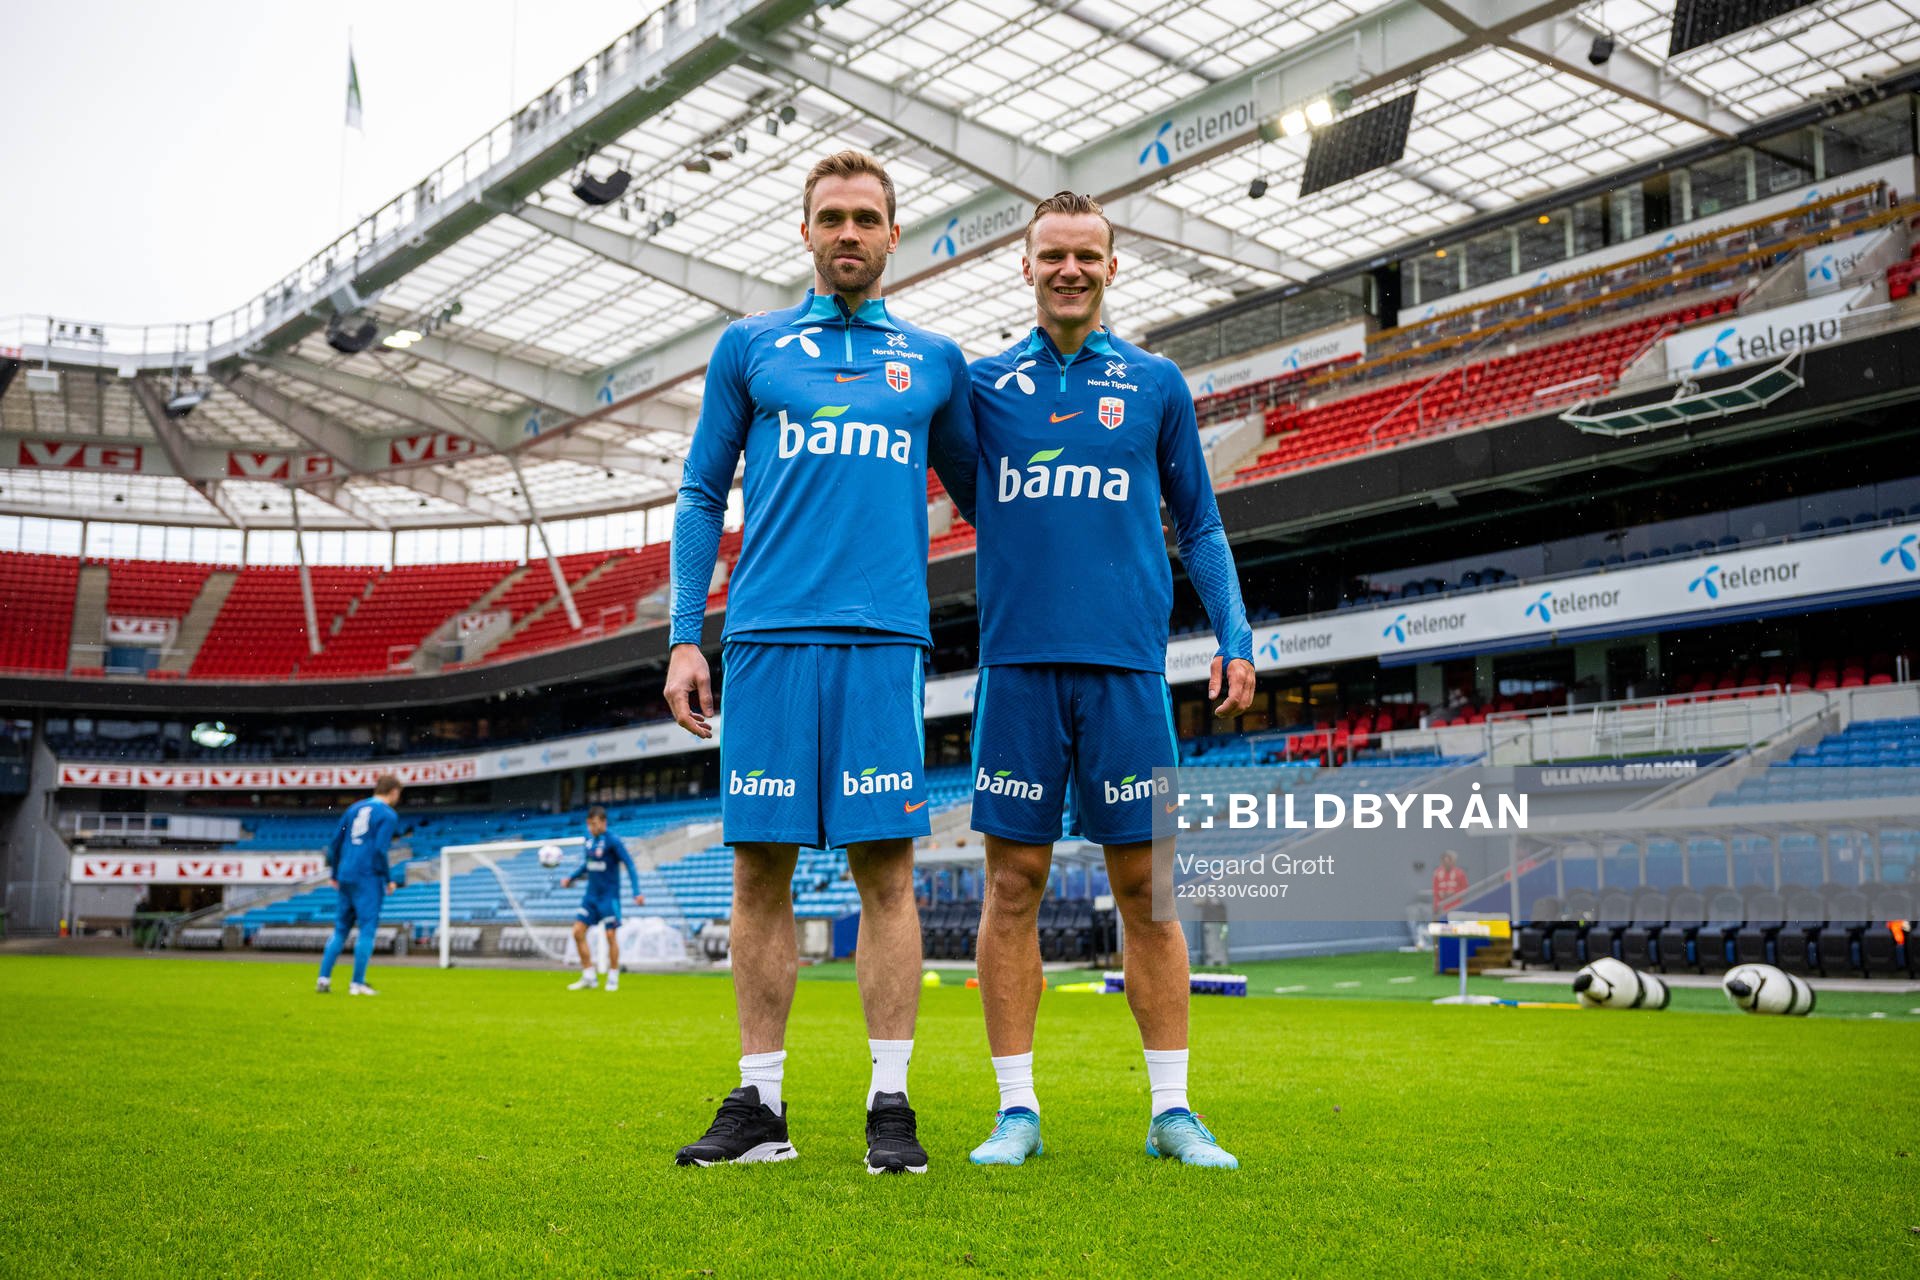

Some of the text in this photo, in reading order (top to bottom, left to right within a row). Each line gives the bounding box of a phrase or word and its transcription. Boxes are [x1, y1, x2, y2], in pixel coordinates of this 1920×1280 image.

[960, 202, 1025, 246] telenor
[872, 348, 924, 361] Norsk Tipping
[1087, 379, 1138, 392] Norsk Tipping
[390, 430, 476, 466] VG
[778, 409, 912, 465] bama
[19, 439, 143, 473] VG
[228, 452, 334, 478] VG
[998, 455, 1130, 503] bama
[1720, 561, 1800, 590] telenor
[1551, 589, 1621, 615] telenor
[1406, 612, 1467, 636] telenor
[1279, 632, 1333, 654] telenor
[729, 770, 796, 797] bama
[843, 771, 913, 796] bama
[975, 767, 1044, 801] bama
[1541, 759, 1697, 786] ULLEVAAL STADION
[1104, 776, 1169, 804] bama
